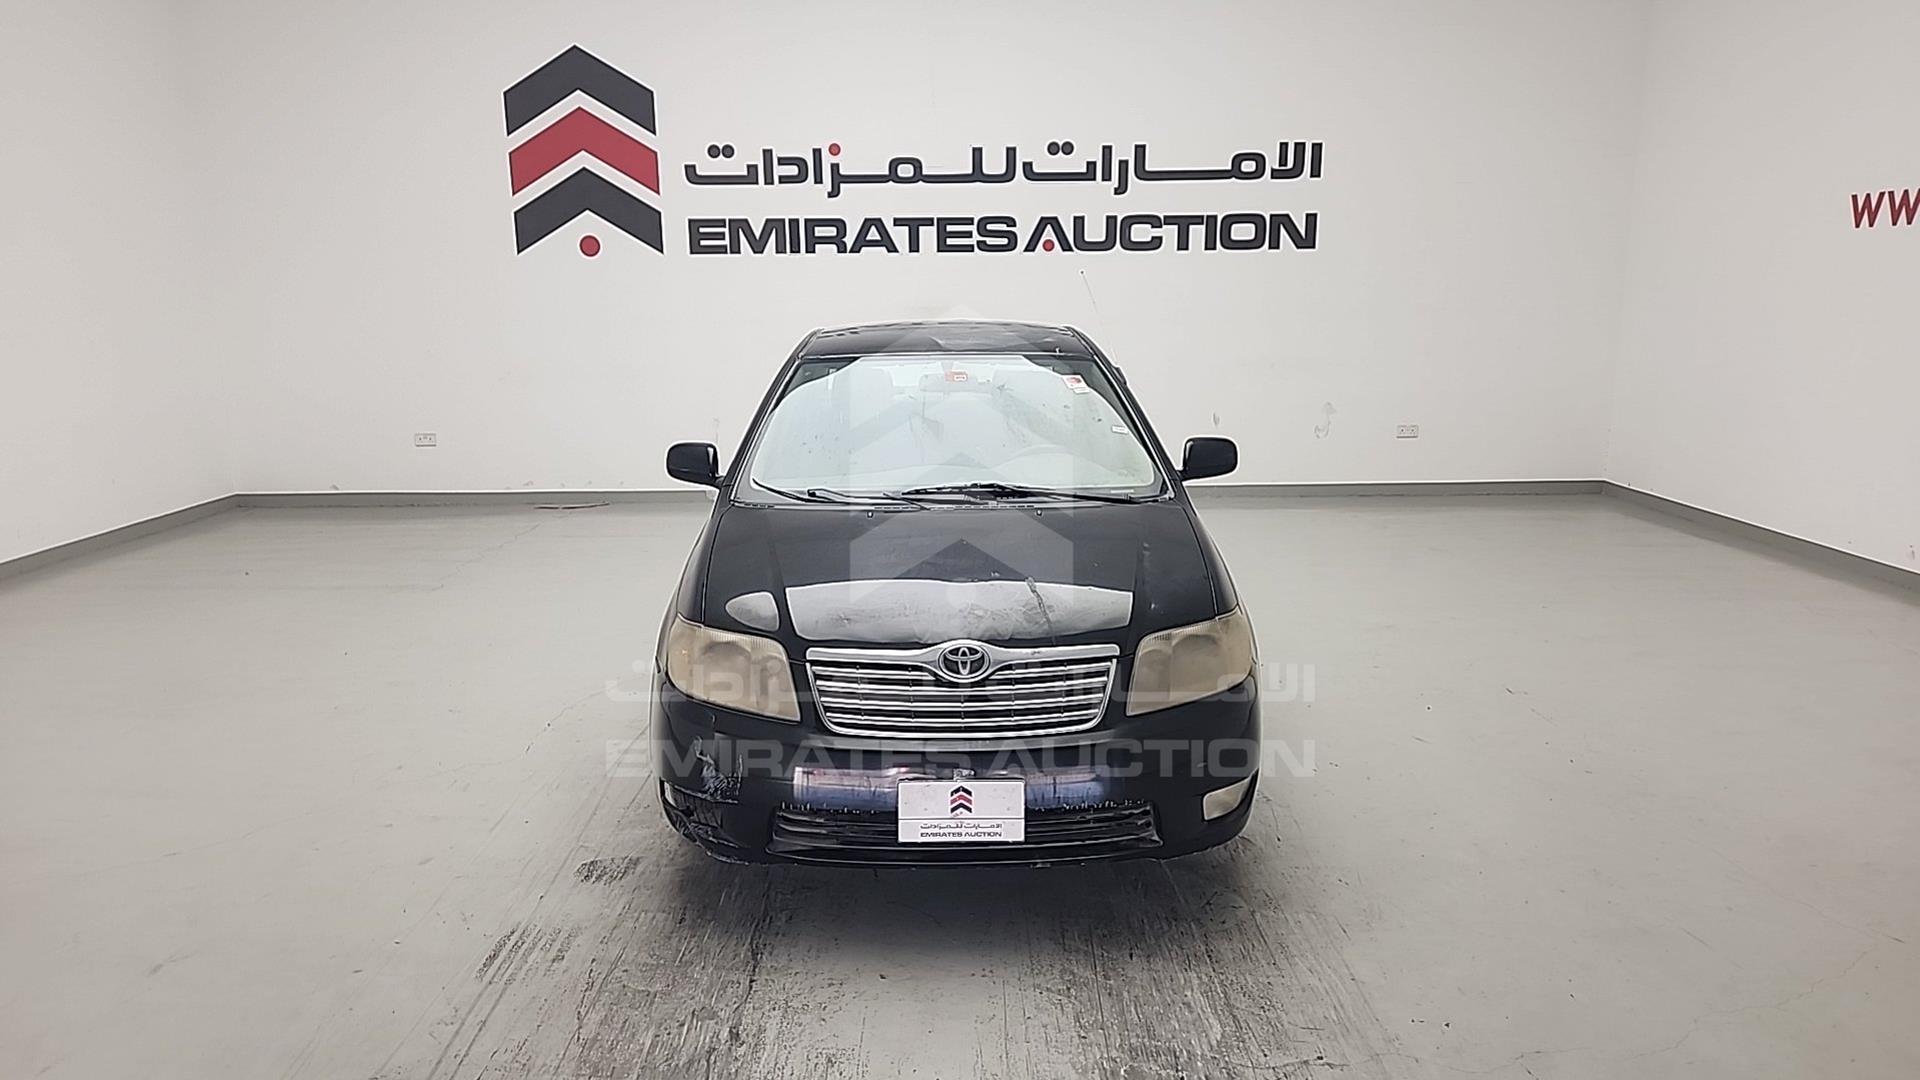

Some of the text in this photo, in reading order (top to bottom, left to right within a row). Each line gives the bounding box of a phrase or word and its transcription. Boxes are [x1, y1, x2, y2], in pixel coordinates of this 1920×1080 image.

[684, 141, 1323, 198] الامارات للمزادات
[688, 213, 1318, 255] EMIRATES AUCTION
